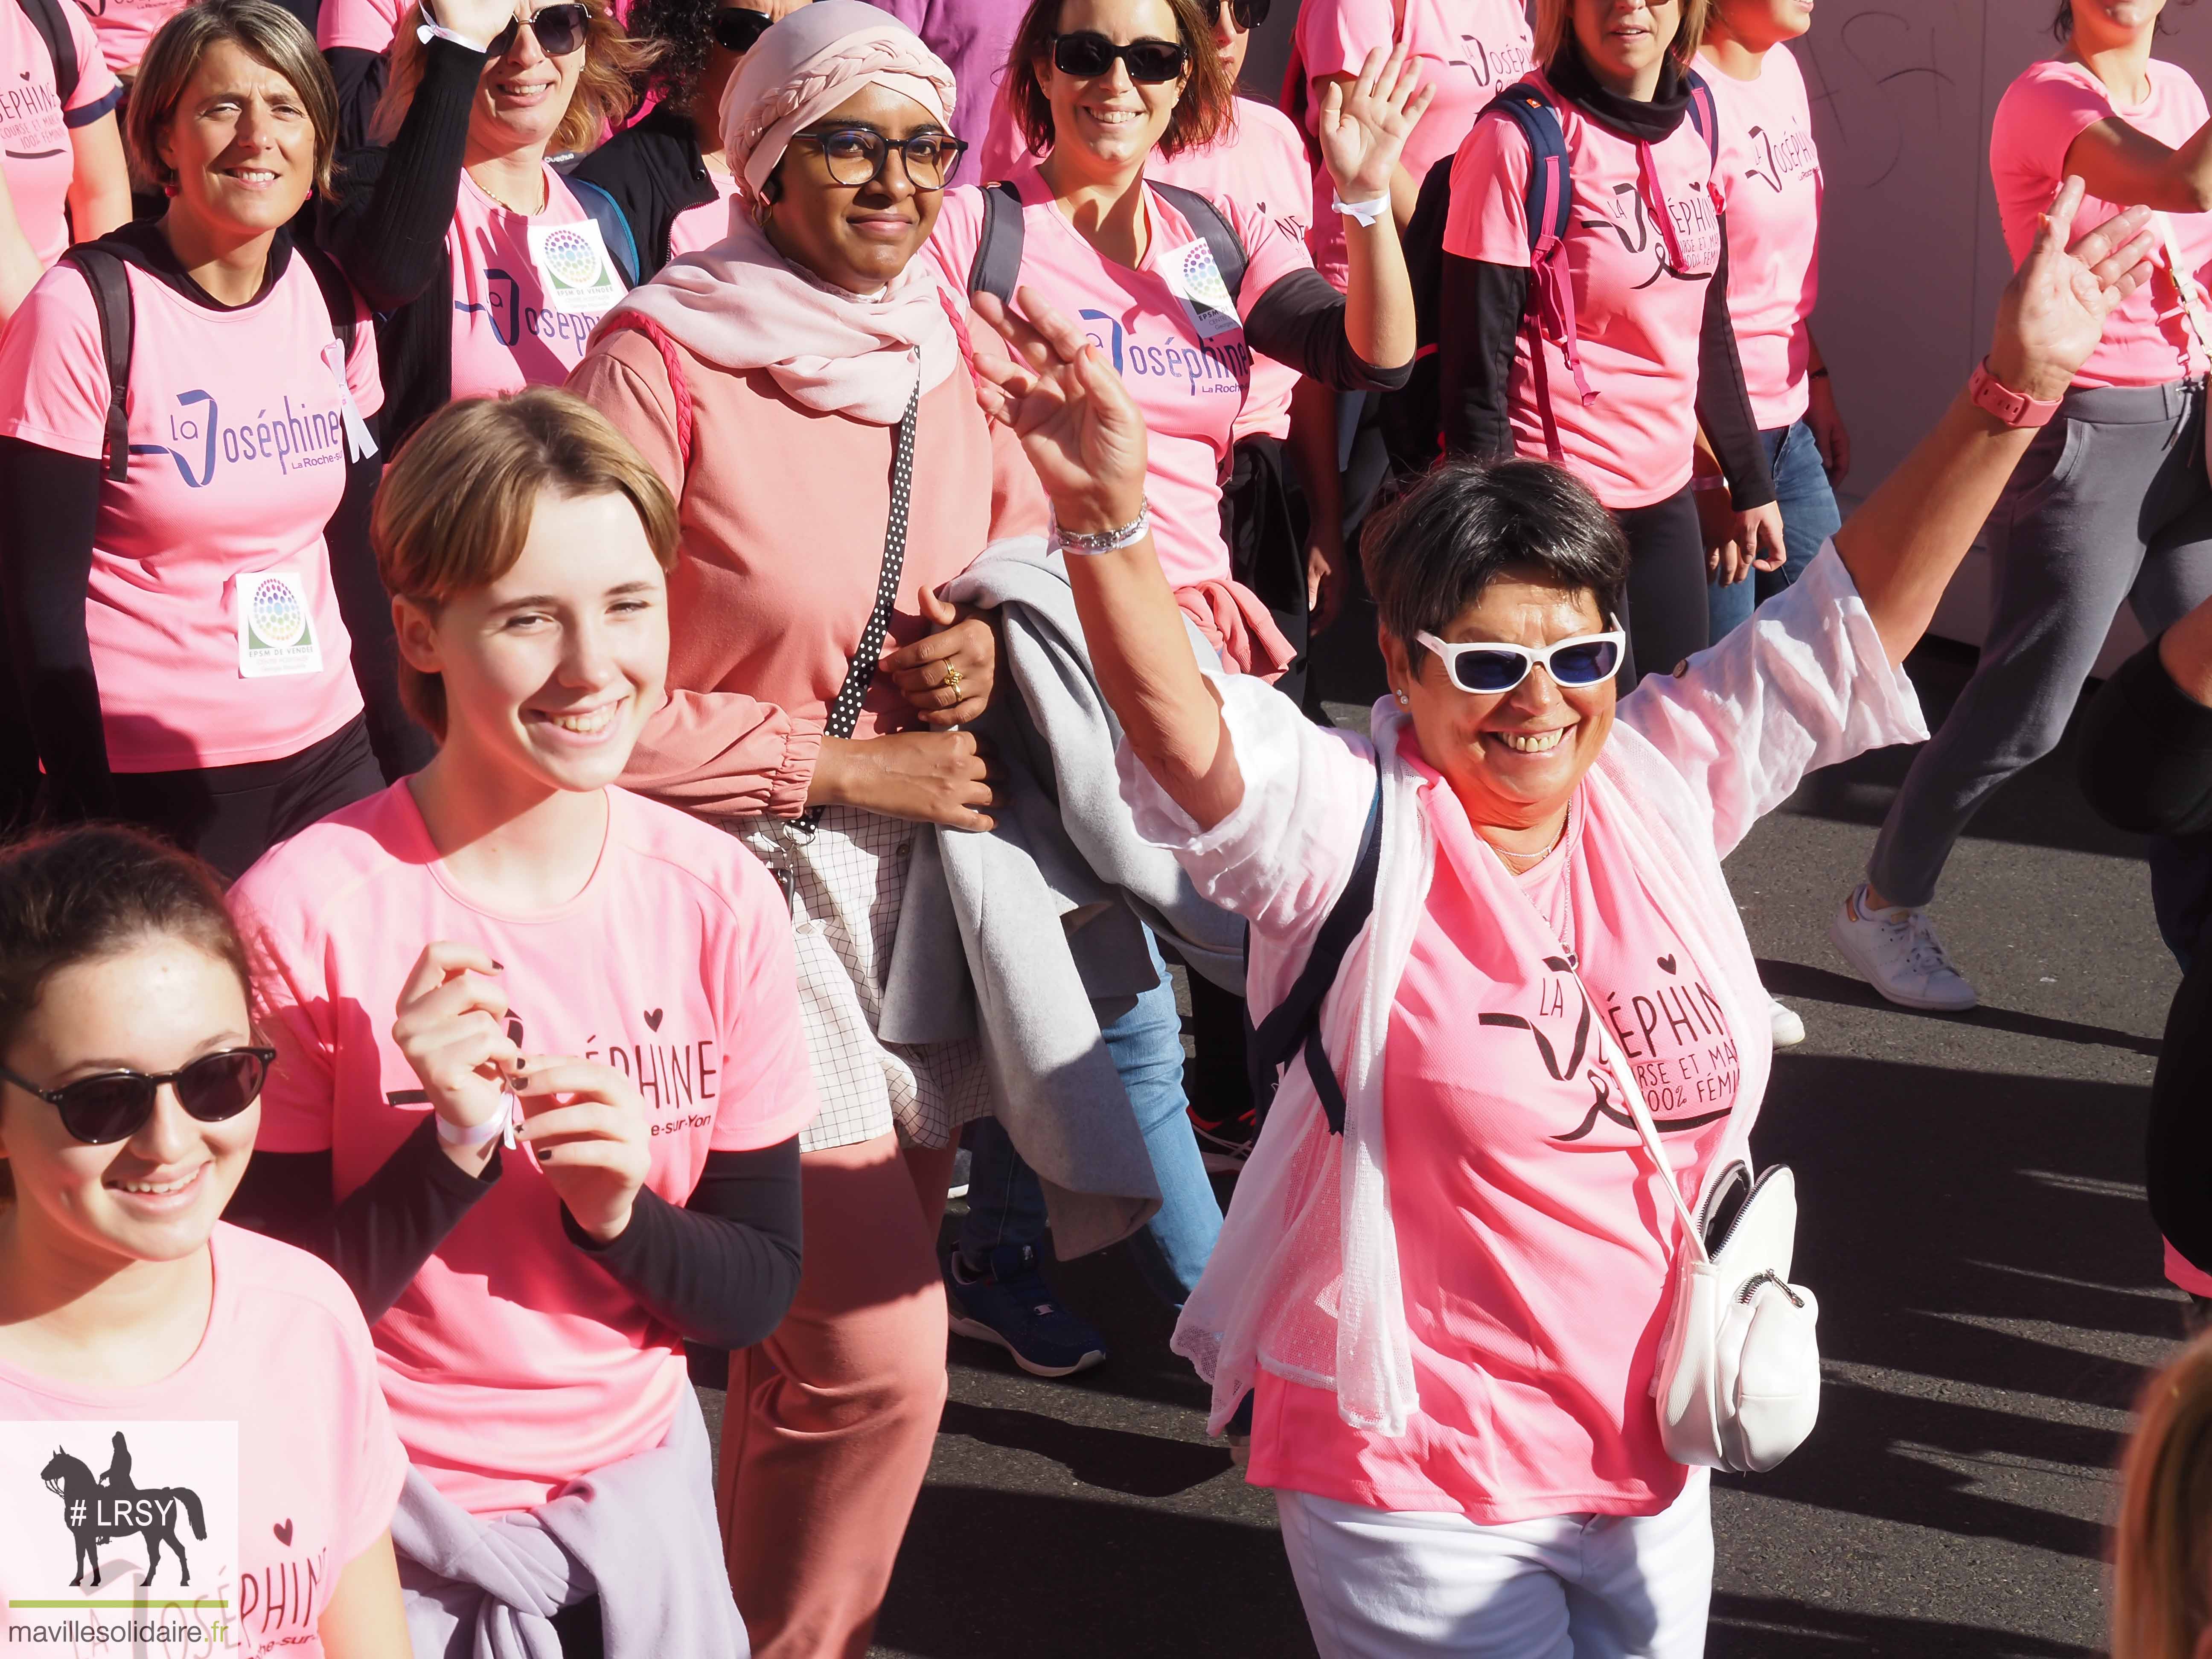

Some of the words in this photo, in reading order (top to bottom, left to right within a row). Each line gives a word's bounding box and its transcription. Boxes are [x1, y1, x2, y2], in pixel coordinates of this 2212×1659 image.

[1607, 199, 1627, 219] LA
[1699, 235, 1707, 251] ET
[1198, 310, 1219, 321] EPSM
[128, 389, 341, 488] Joséphine
[170, 414, 198, 441] la
[1540, 978, 1564, 1018] LA
[1679, 1054, 1699, 1080] ET
[651, 1114, 711, 1136] e-sur-Yon
